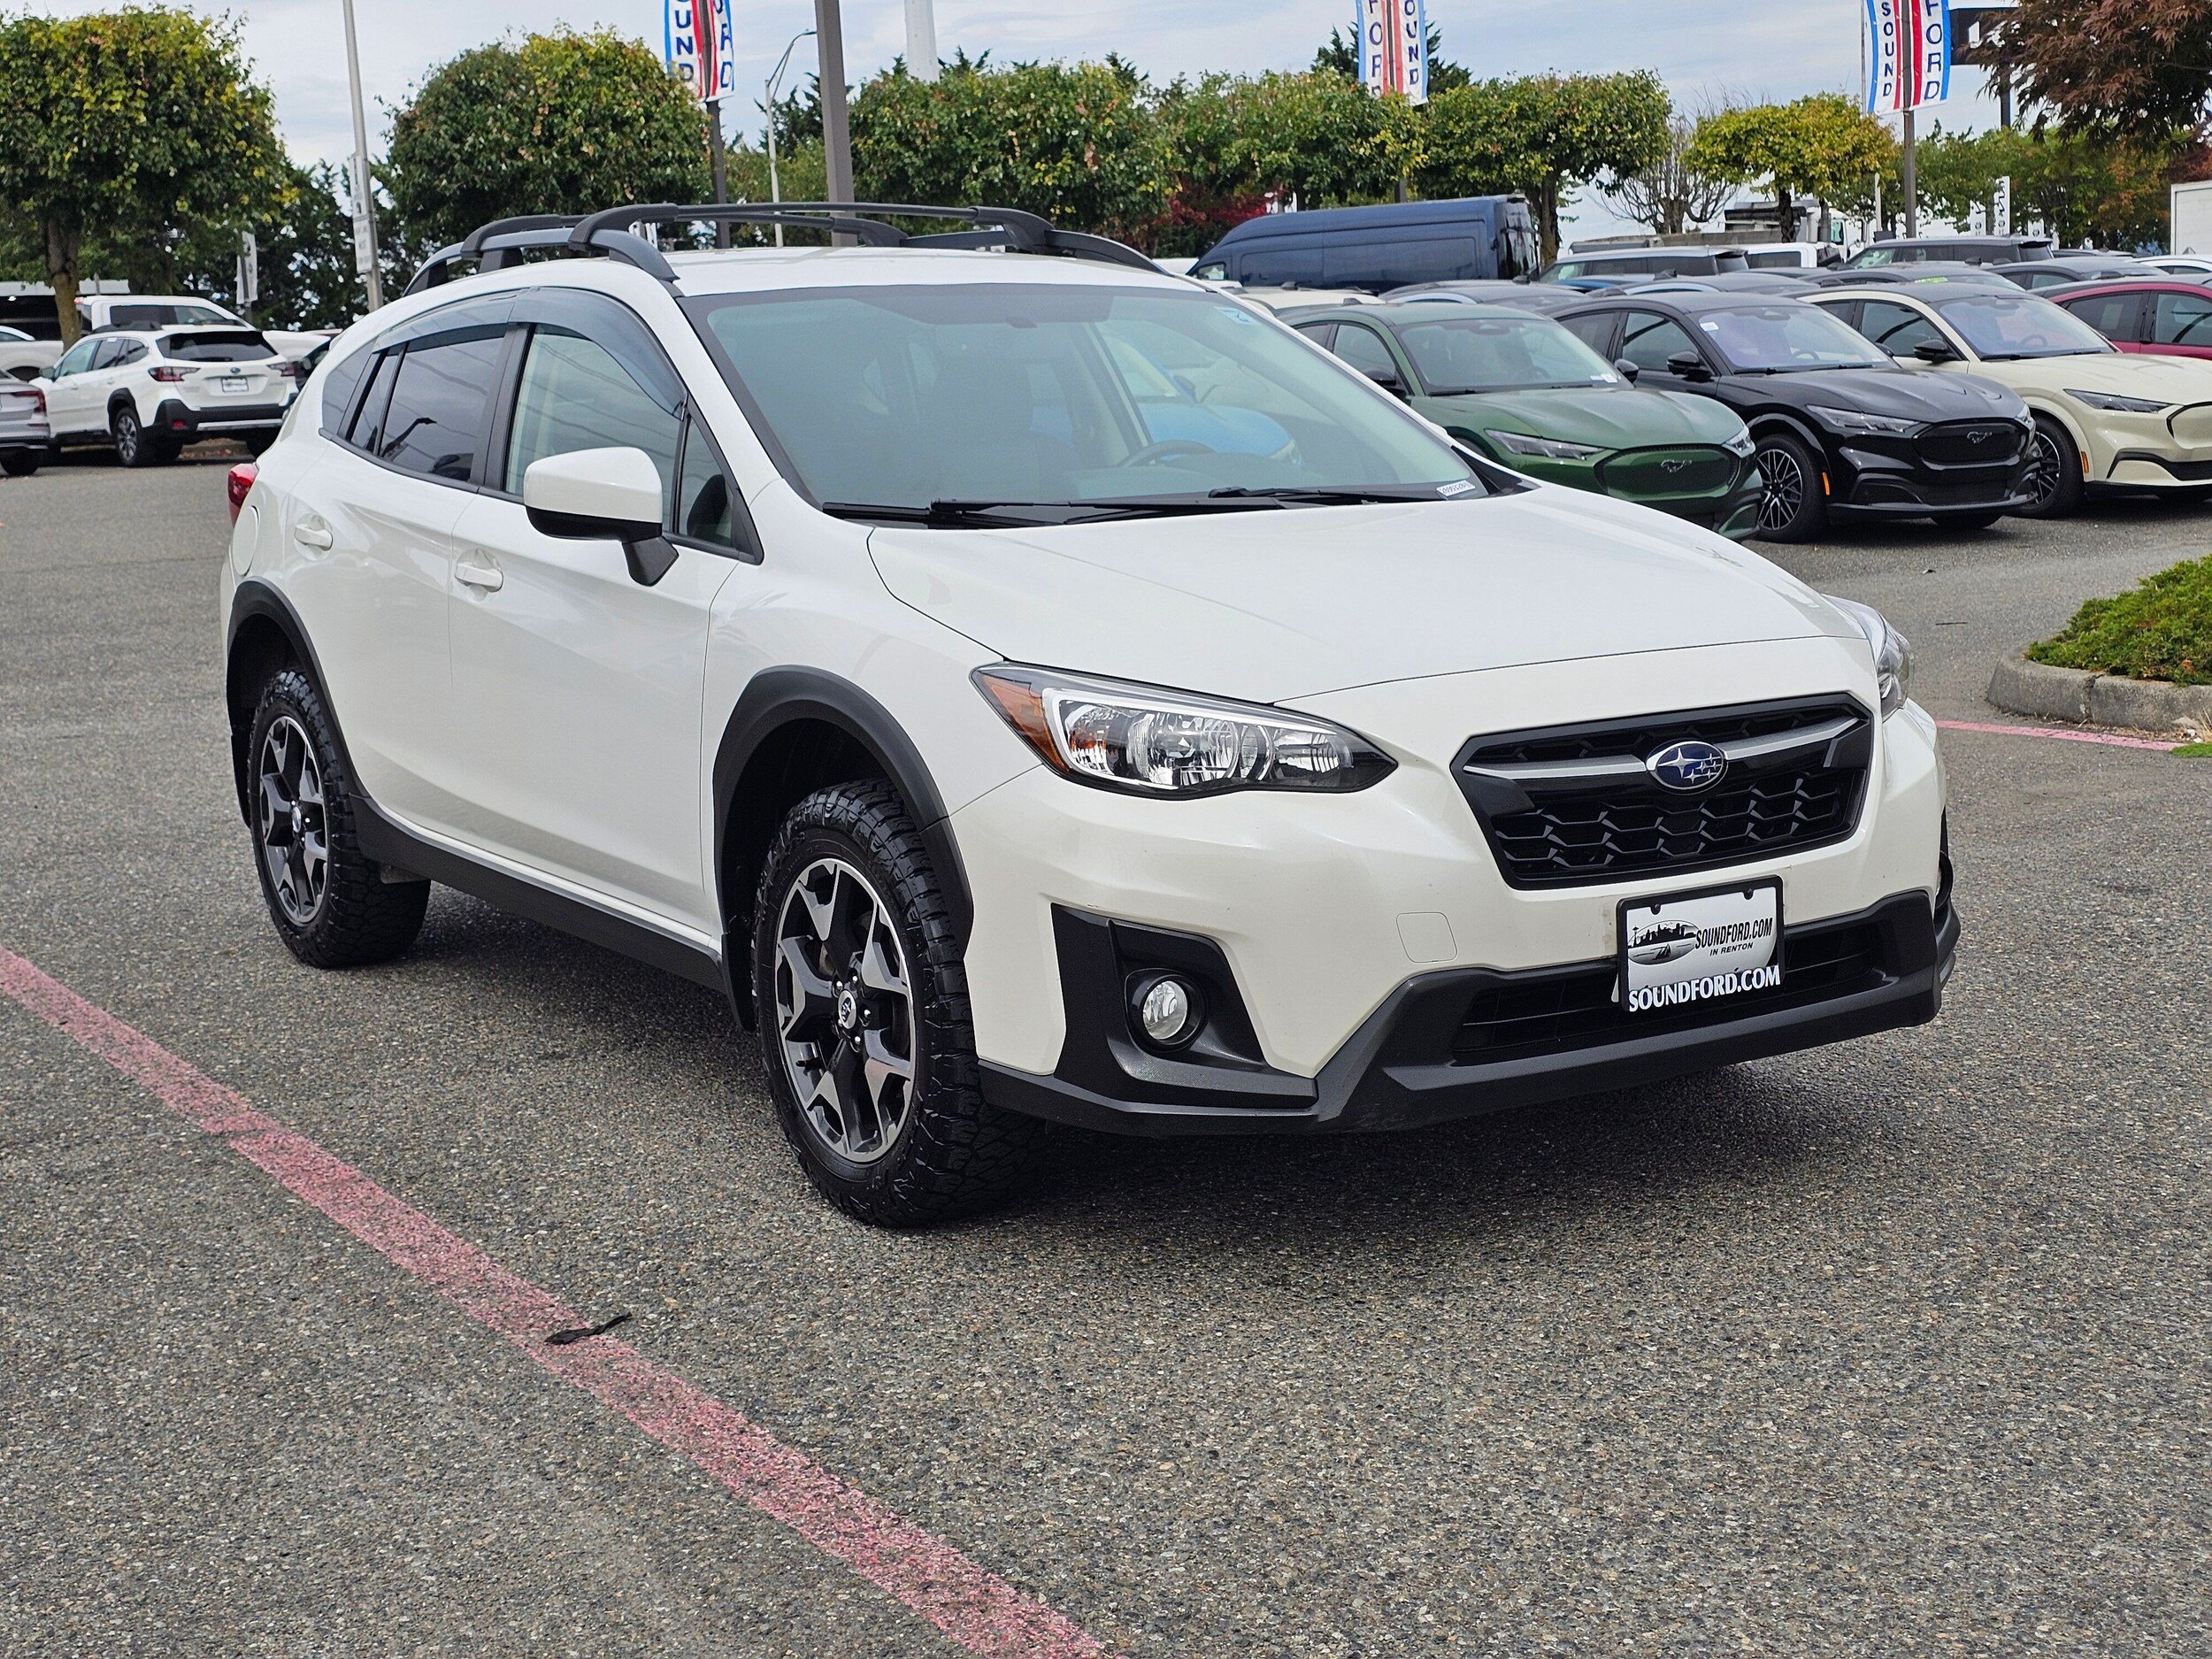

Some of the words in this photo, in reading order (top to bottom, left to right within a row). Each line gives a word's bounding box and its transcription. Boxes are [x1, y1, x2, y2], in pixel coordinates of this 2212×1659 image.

[675, 0, 695, 82] UND
[1881, 2, 1894, 97] SOUND
[1924, 0, 1942, 101] FORD
[1695, 918, 1773, 949] SOUNDFORD.COM
[1709, 948, 1718, 957] IN
[1721, 941, 1754, 955] RENTON
[1629, 964, 1781, 1012] SOUNDFORD.COM
